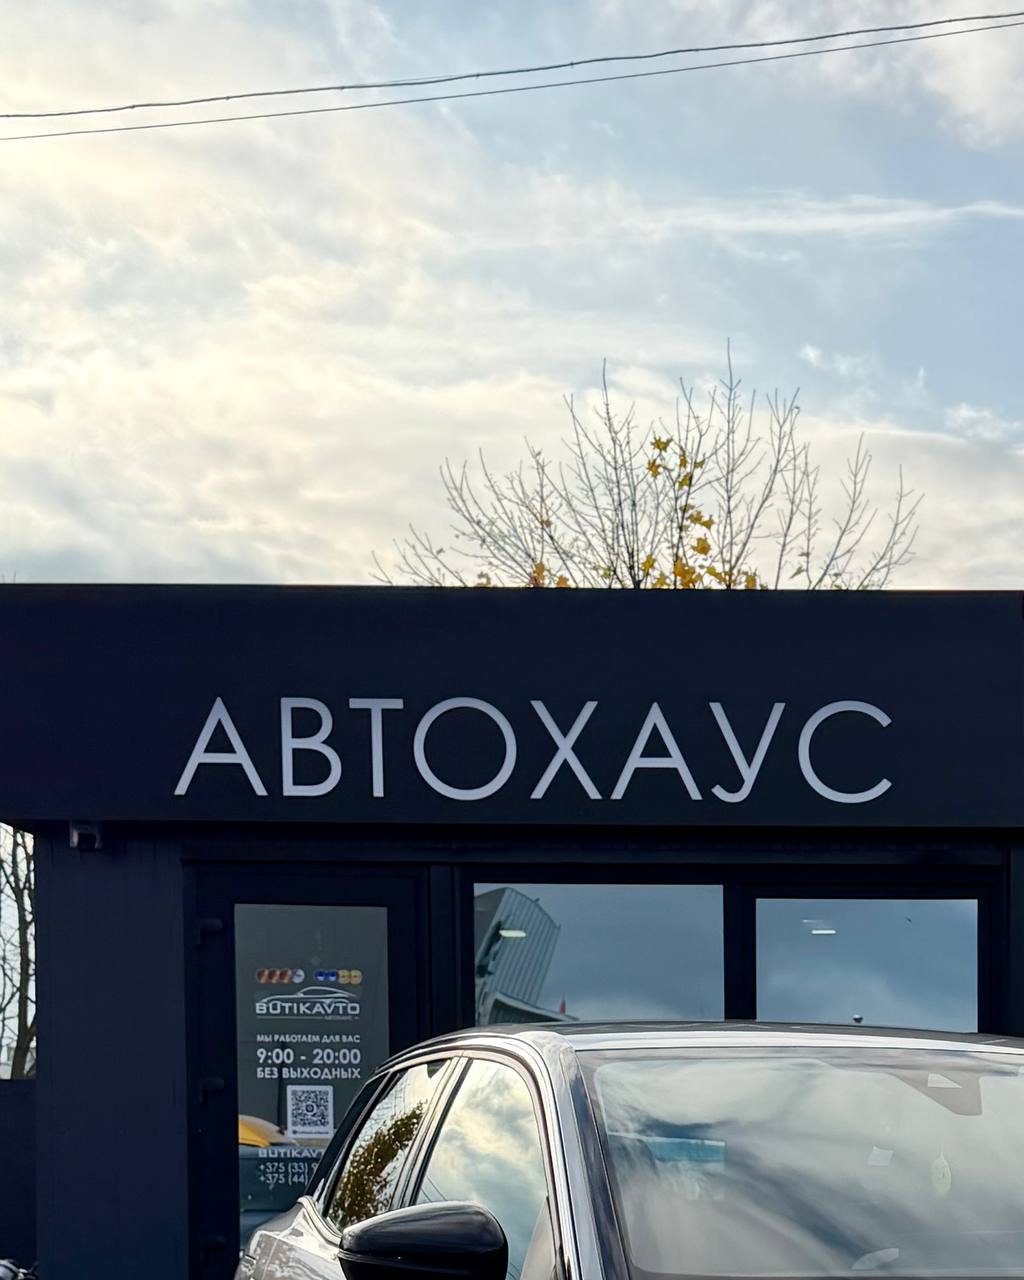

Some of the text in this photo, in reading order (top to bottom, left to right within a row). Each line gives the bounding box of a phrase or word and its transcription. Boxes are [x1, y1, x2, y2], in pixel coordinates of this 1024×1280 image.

[173, 696, 893, 804] АВТОХАУС
[255, 1001, 360, 1014] BUTIKAVTO
[256, 1034, 272, 1043] МЫ
[274, 1034, 320, 1043] РАБОТАЕМ
[342, 1034, 361, 1043] ВАС
[256, 1048, 294, 1064] 9:00
[312, 1048, 361, 1064] 20:00
[256, 1067, 361, 1080] БЕЗ ВЫХОДНЫХ
[259, 1162, 286, 1172] +375
[288, 1162, 308, 1174] (33)
